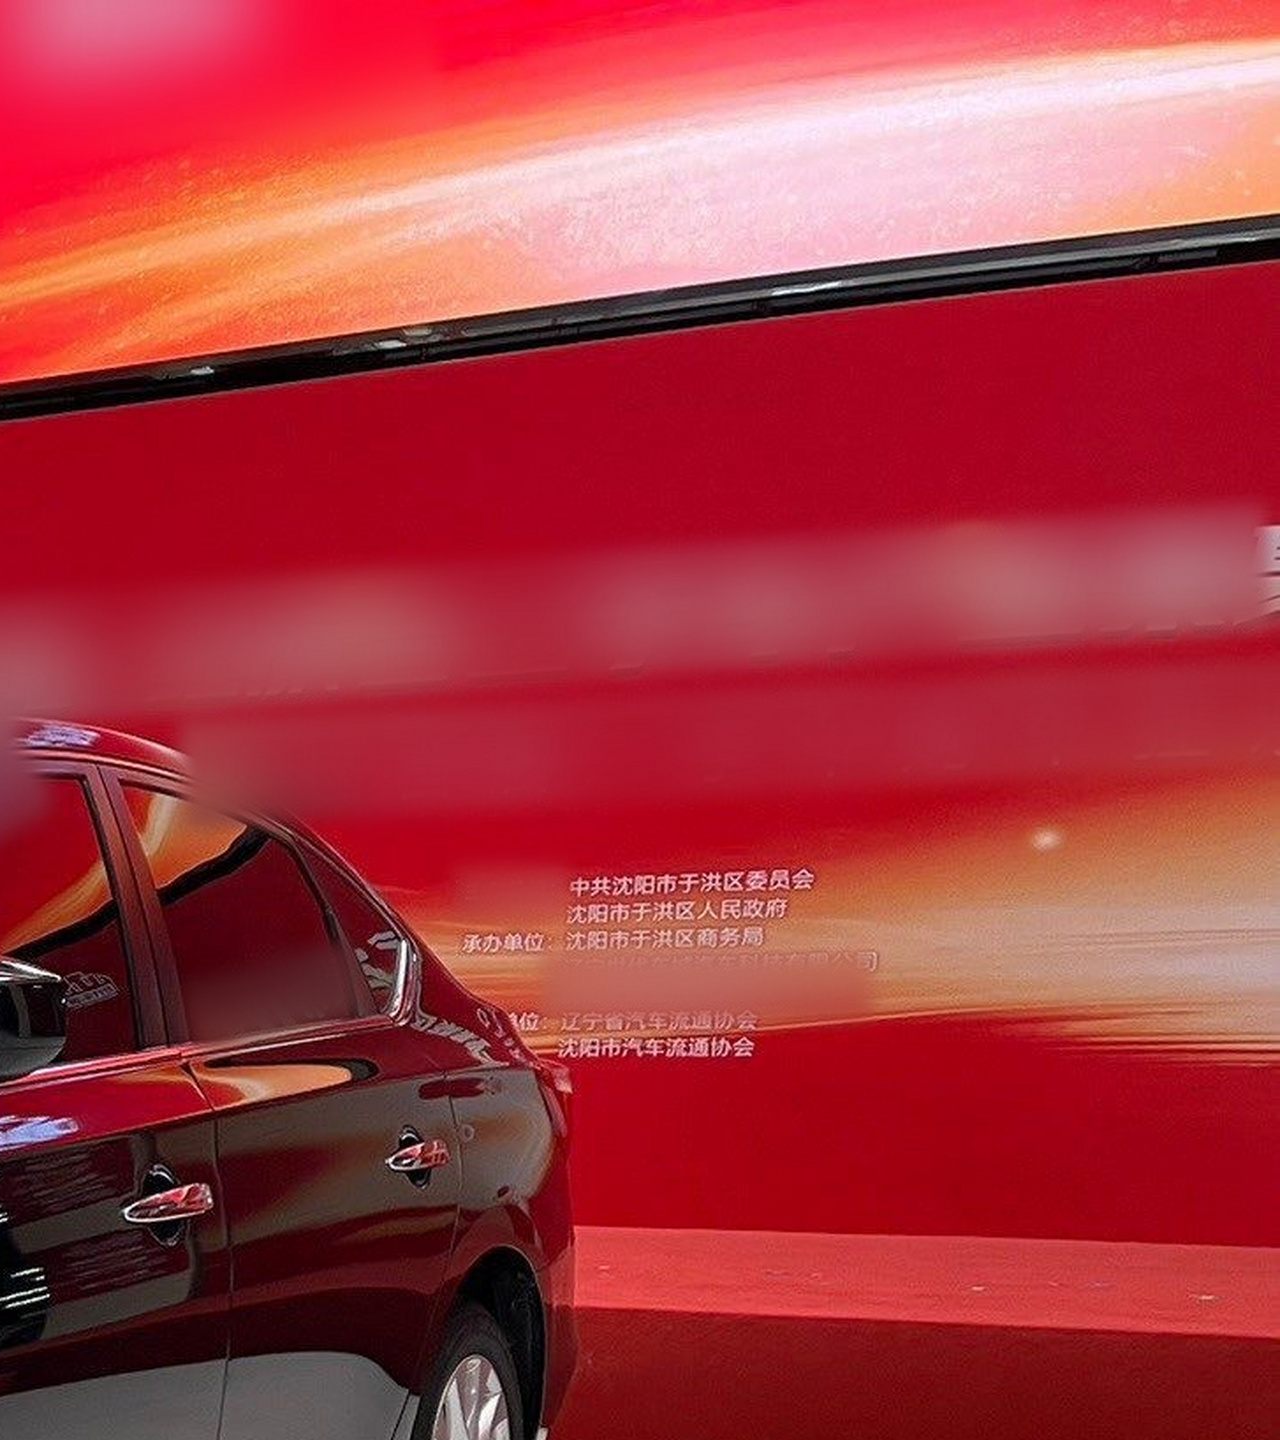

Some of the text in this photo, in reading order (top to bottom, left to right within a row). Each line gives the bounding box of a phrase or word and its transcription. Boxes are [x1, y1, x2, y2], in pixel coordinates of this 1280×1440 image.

[570, 869, 815, 897] 中共沈阳市于洪区委员会
[566, 898, 788, 924] 沈阳市于洪区人民政府
[565, 926, 765, 950] 沈阳市于洪区商务局
[557, 1036, 755, 1058] 沈阳市汽车流通协会
